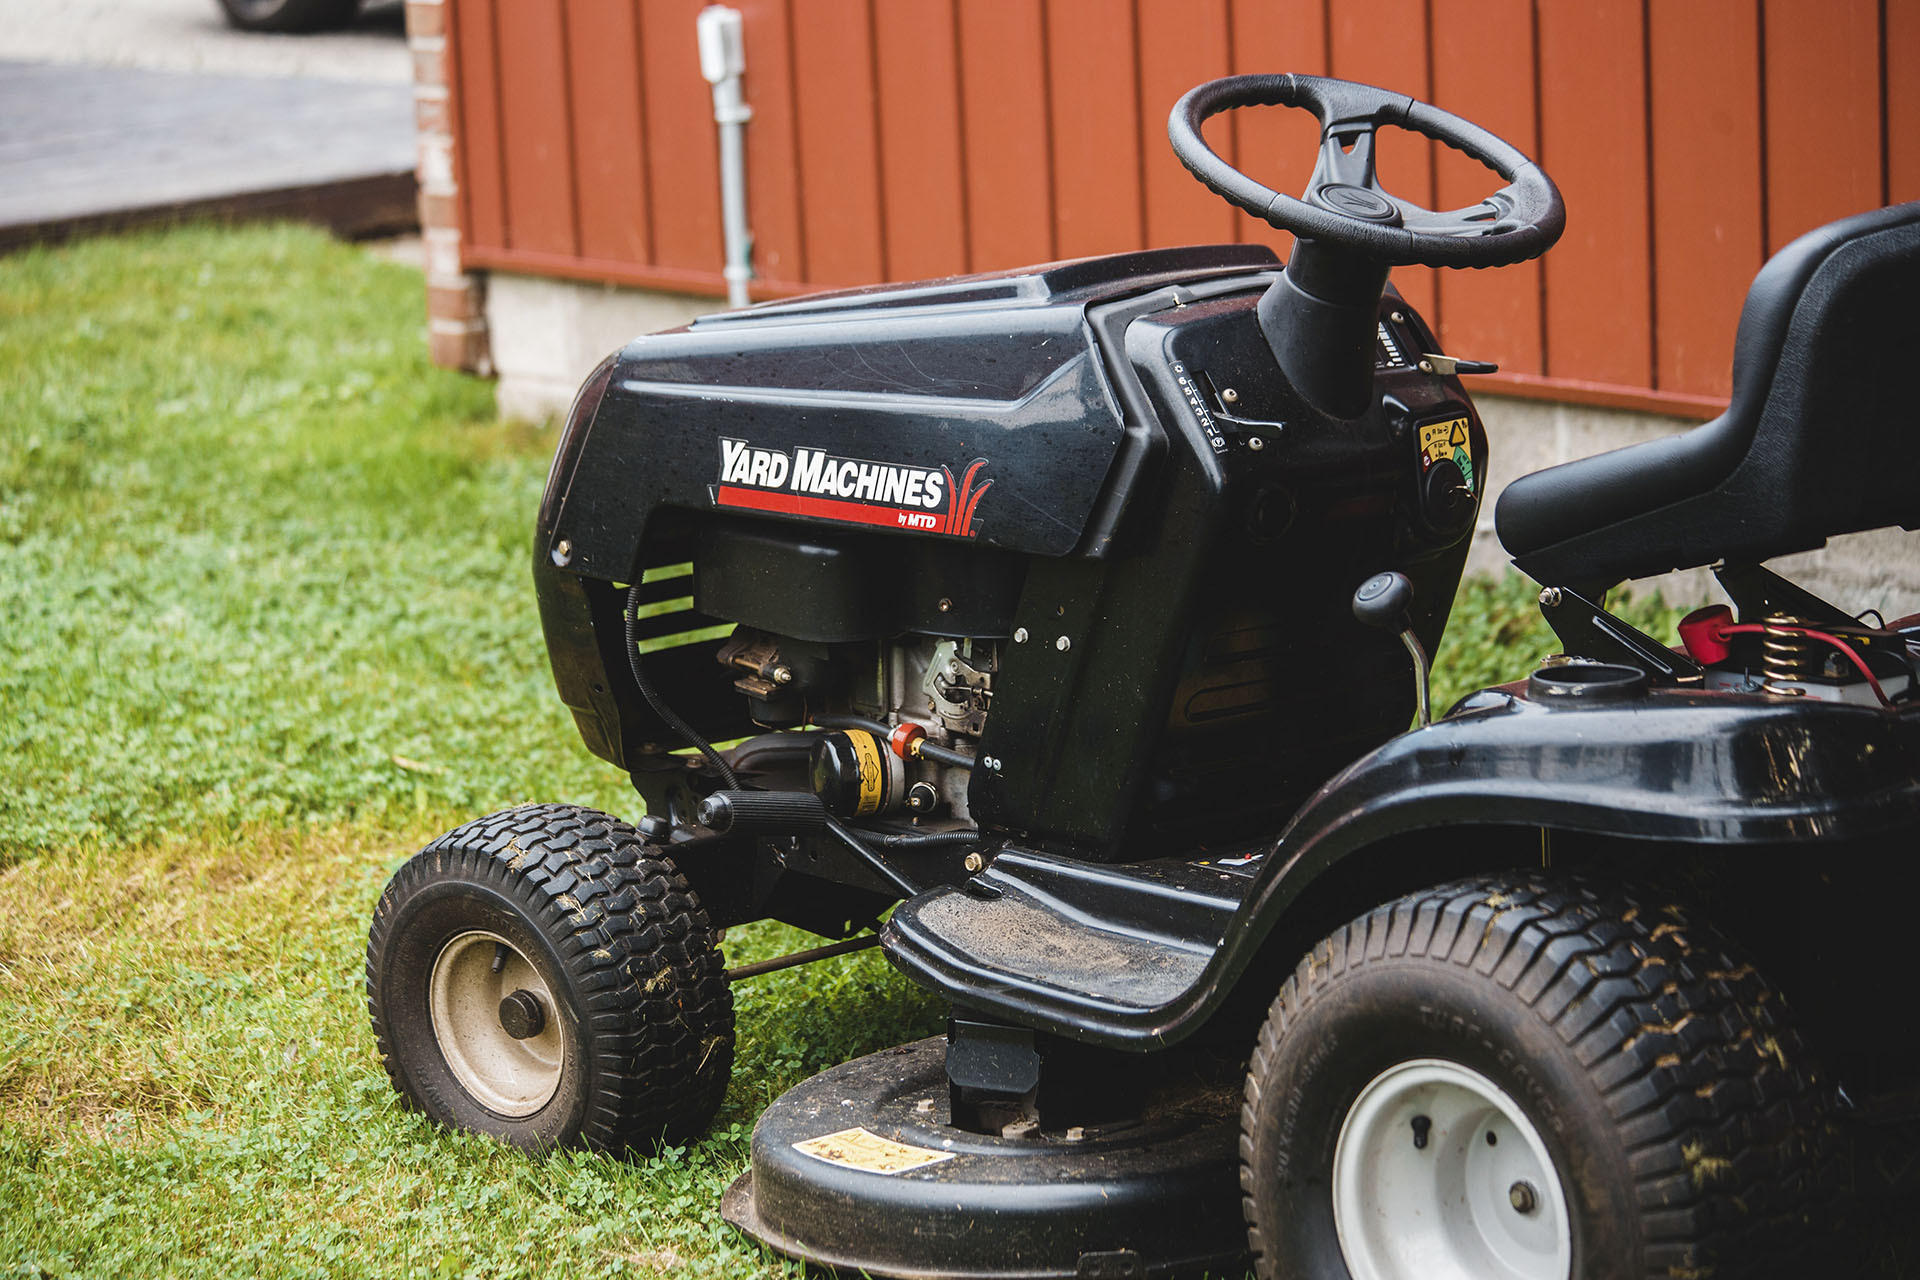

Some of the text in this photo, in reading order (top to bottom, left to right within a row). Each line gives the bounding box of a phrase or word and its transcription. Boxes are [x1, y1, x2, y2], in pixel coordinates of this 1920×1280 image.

[1178, 376, 1214, 437] 6 5 4 3 2 1
[722, 440, 944, 509] YARD MACHINES
[898, 512, 936, 528] by MTD
